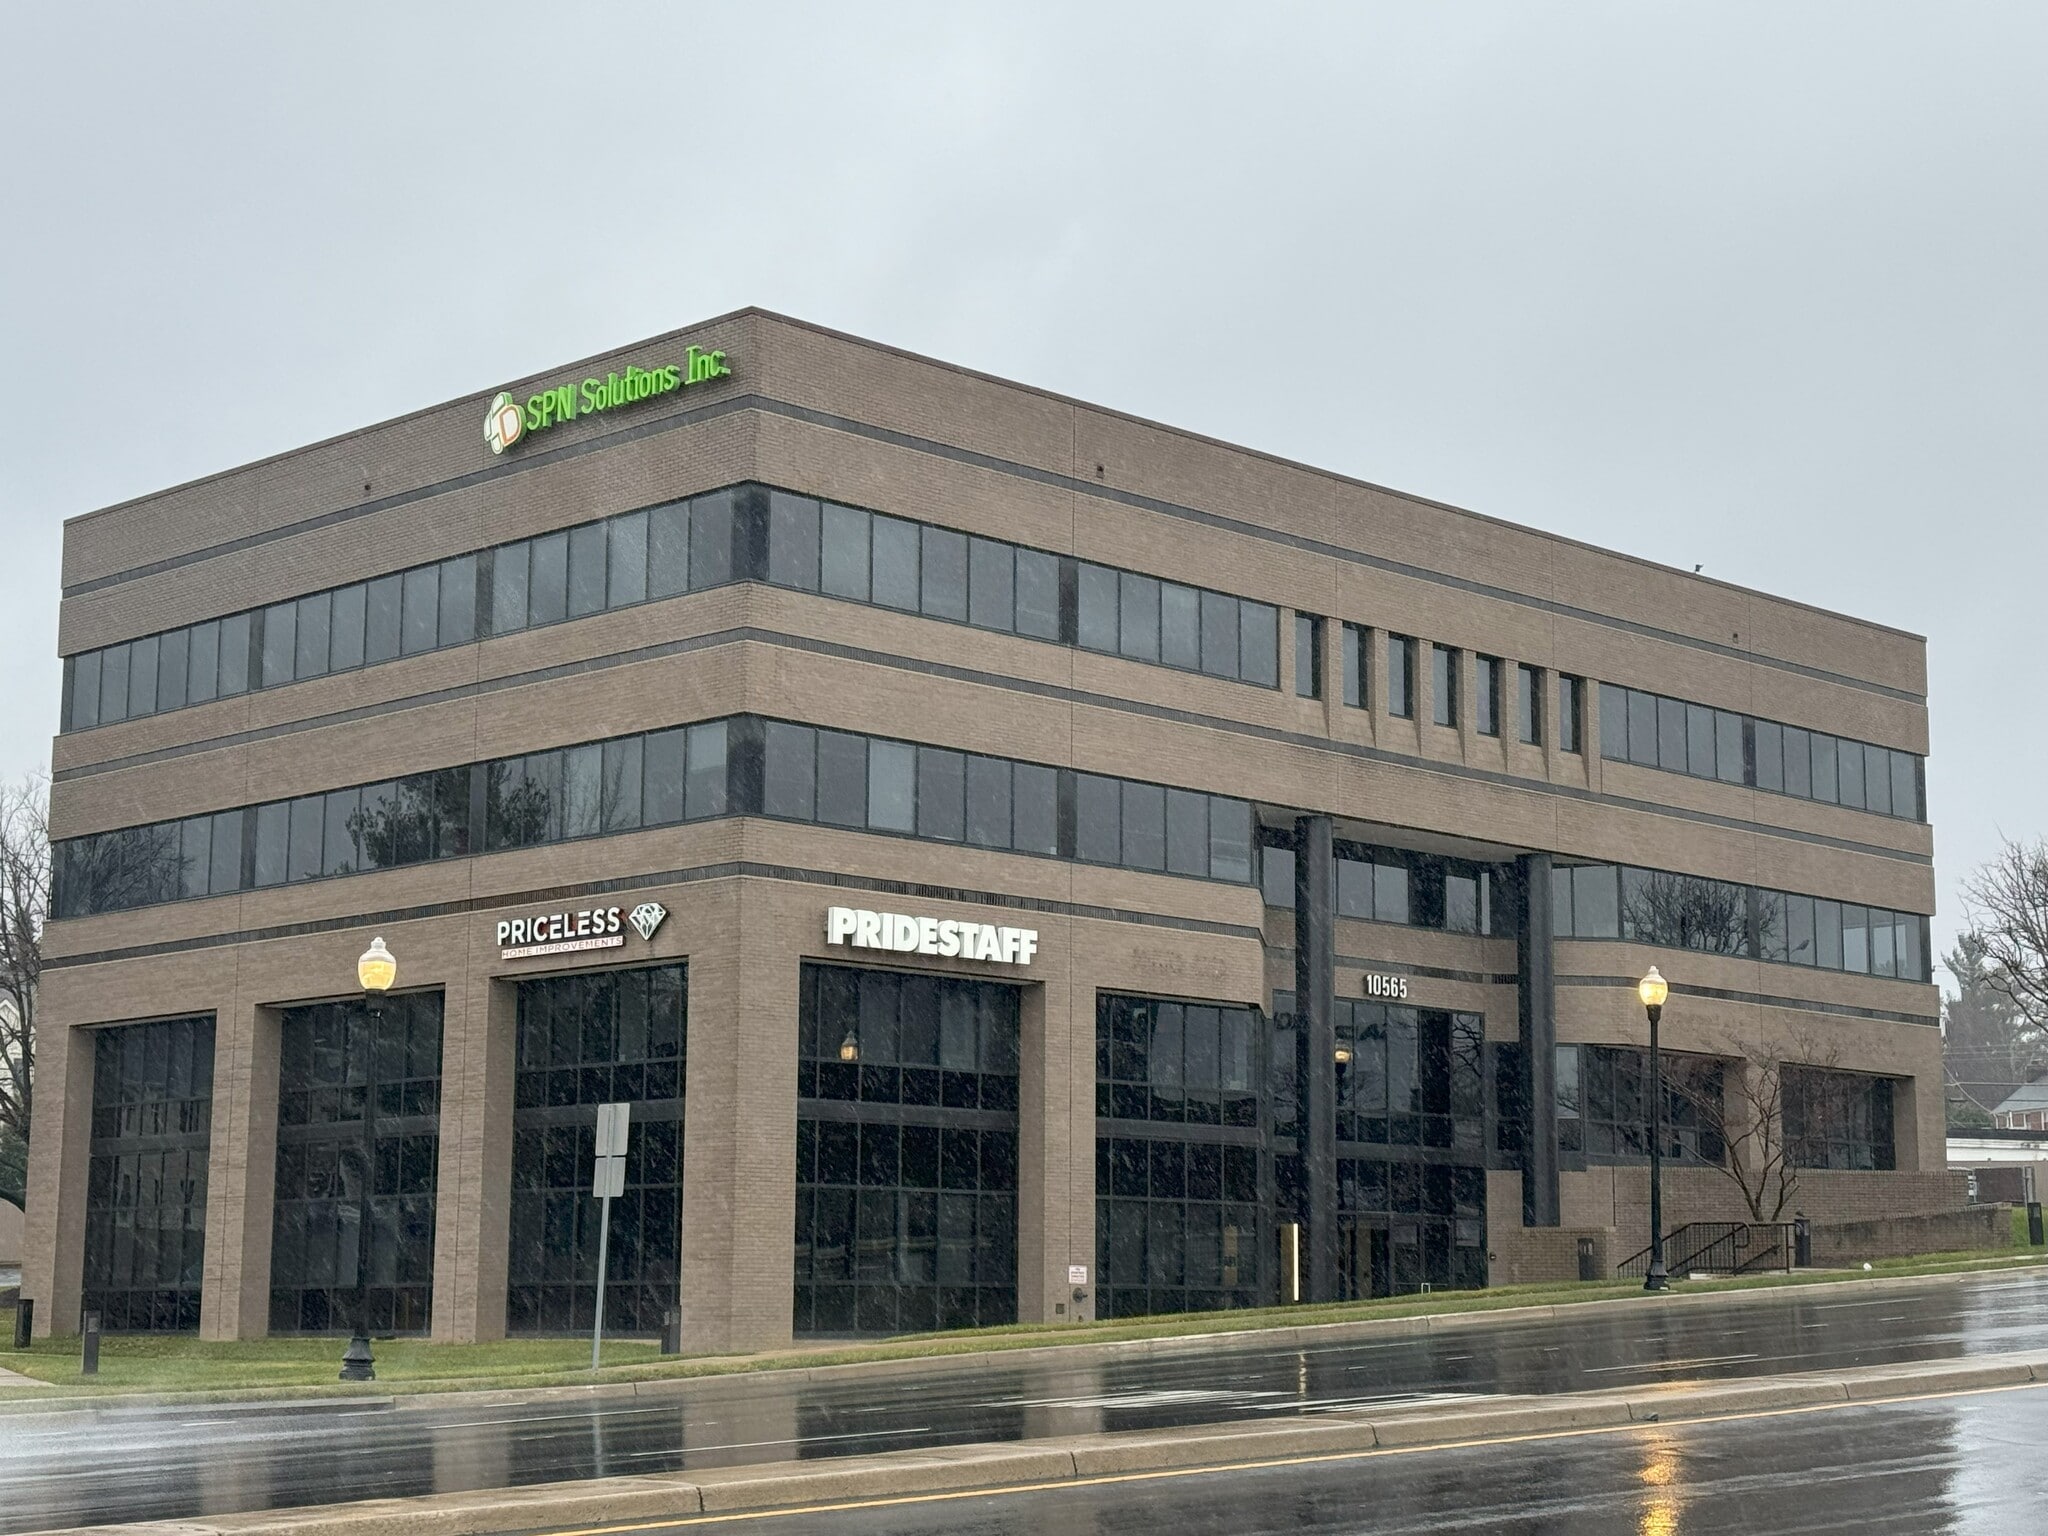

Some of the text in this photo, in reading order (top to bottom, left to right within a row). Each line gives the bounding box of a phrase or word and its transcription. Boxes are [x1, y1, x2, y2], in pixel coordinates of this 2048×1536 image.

[526, 345, 731, 430] SPN Solutions Inc.
[497, 907, 621, 945] PRICELESS
[827, 906, 1038, 964] PRIDESTAFF
[502, 937, 623, 958] HOME IMPROVEMENTS
[1366, 974, 1407, 998] 10565
